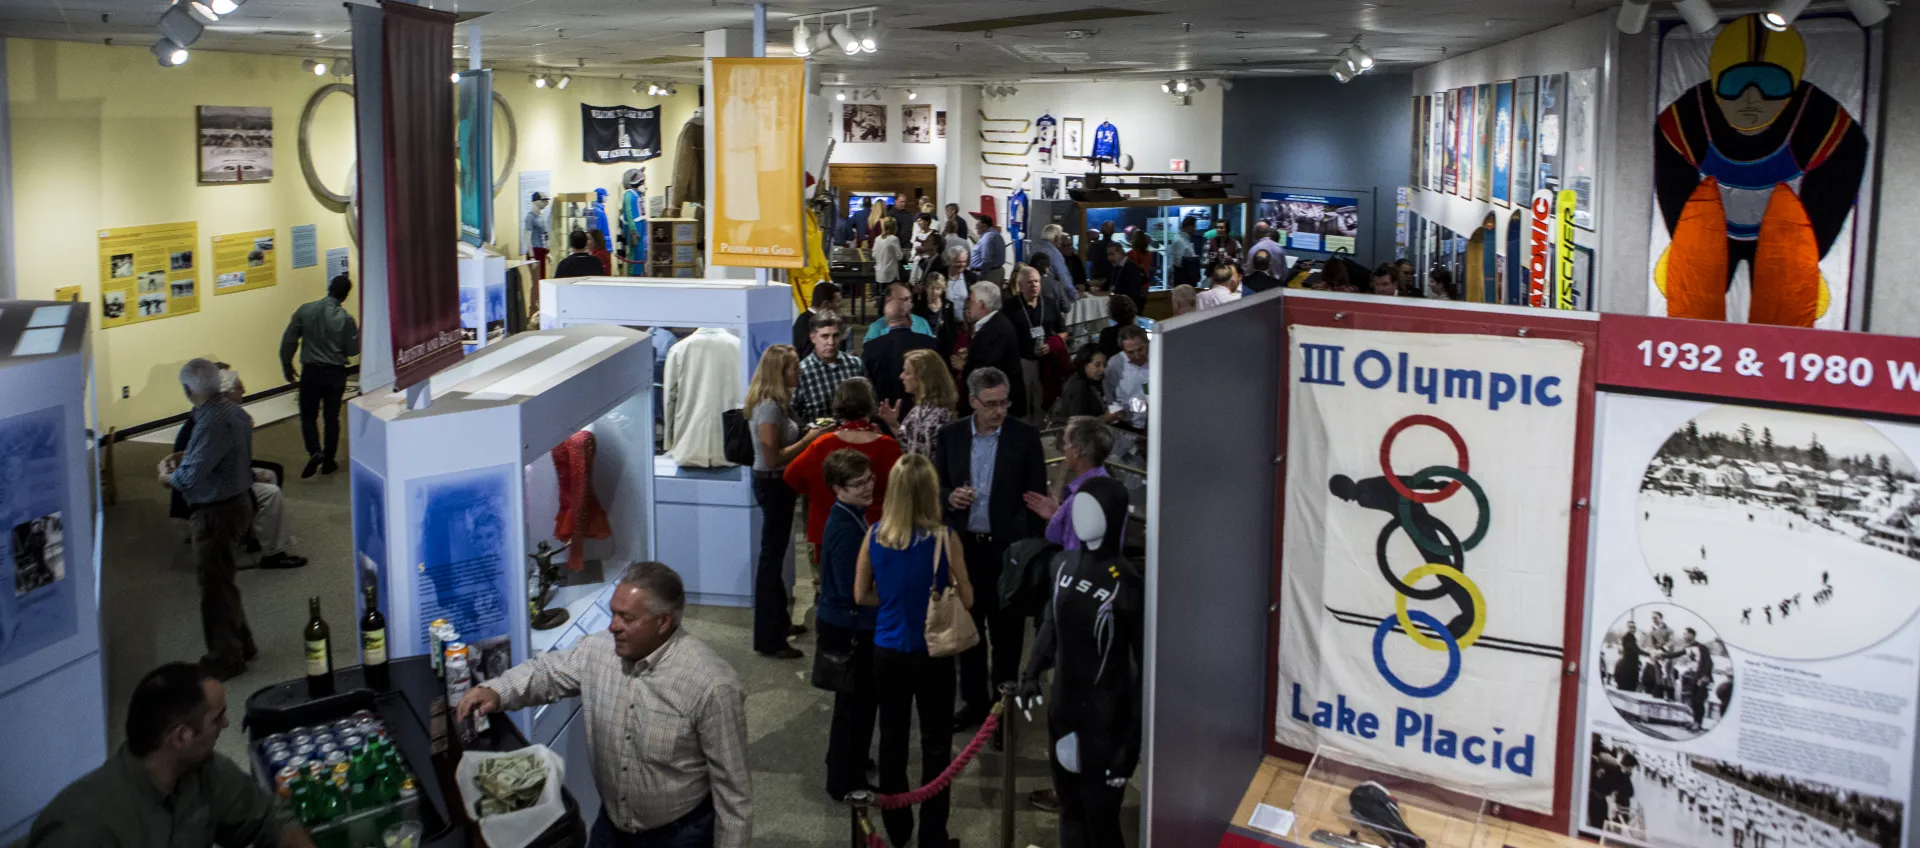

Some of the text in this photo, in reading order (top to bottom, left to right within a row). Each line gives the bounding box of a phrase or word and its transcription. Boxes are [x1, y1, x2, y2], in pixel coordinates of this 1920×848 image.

[1528, 197, 1548, 308] ATOMIC
[1299, 343, 1562, 411] III Olympic
[1637, 339, 1722, 374] 1932
[1735, 347, 1765, 378] &
[1778, 351, 1874, 387] 1980
[1059, 574, 1111, 602] USA
[1291, 682, 1535, 777] Lake Placid
